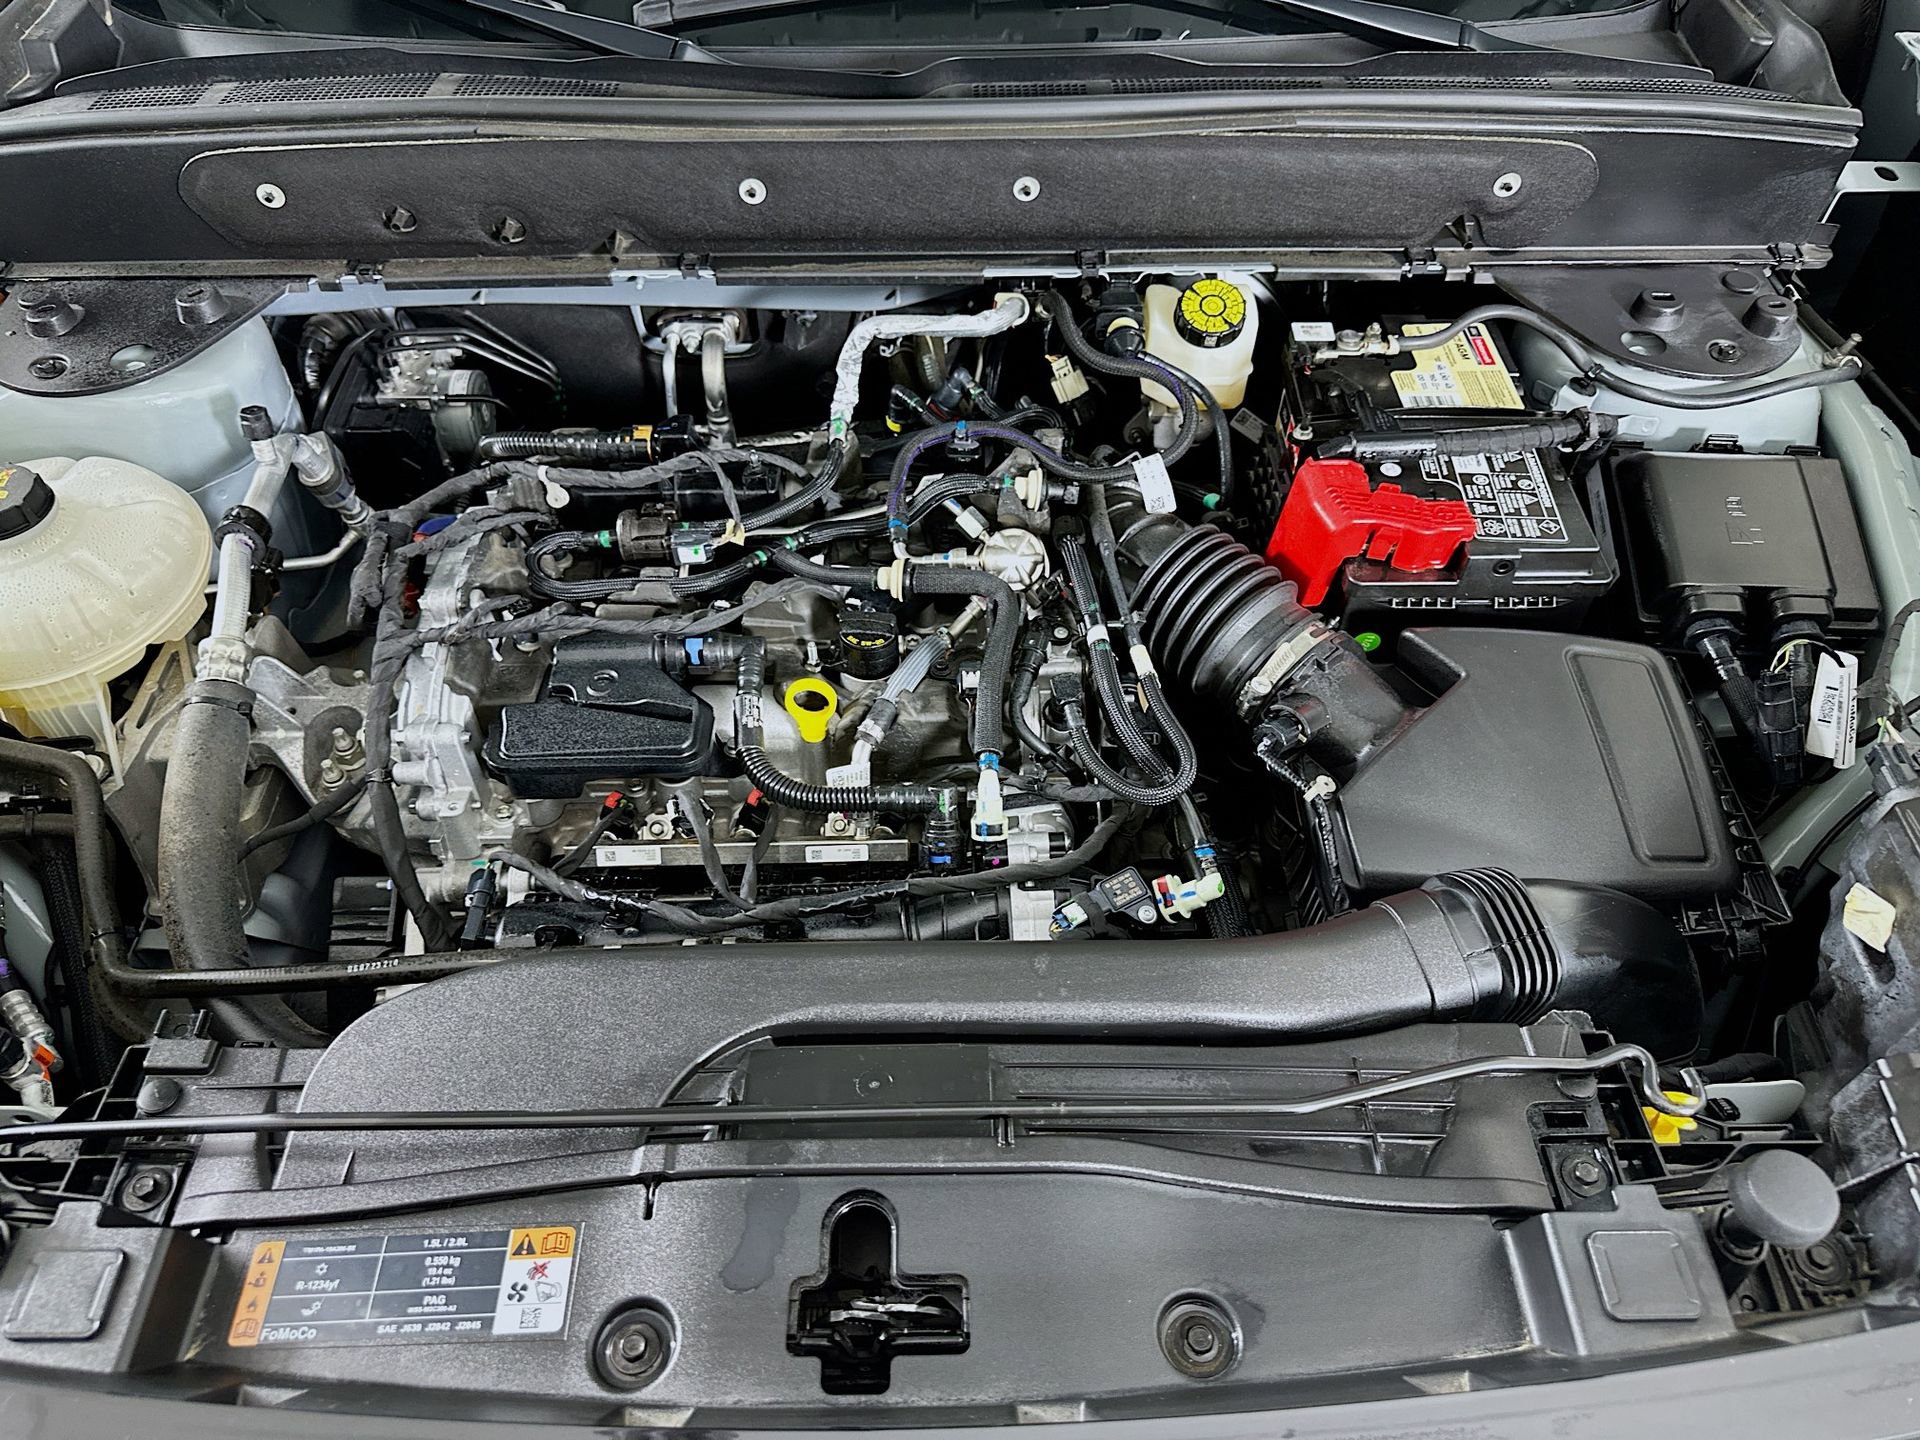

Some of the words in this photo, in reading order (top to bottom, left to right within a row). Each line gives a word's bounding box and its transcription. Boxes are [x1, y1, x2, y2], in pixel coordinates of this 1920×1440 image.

[1456, 343, 1471, 360] AGM
[448, 1255, 461, 1267] kg
[295, 1279, 341, 1292] R-1234yf
[422, 1295, 447, 1305] PAG
[260, 1326, 318, 1341] FoMoCo
[377, 1324, 397, 1334] SAE
